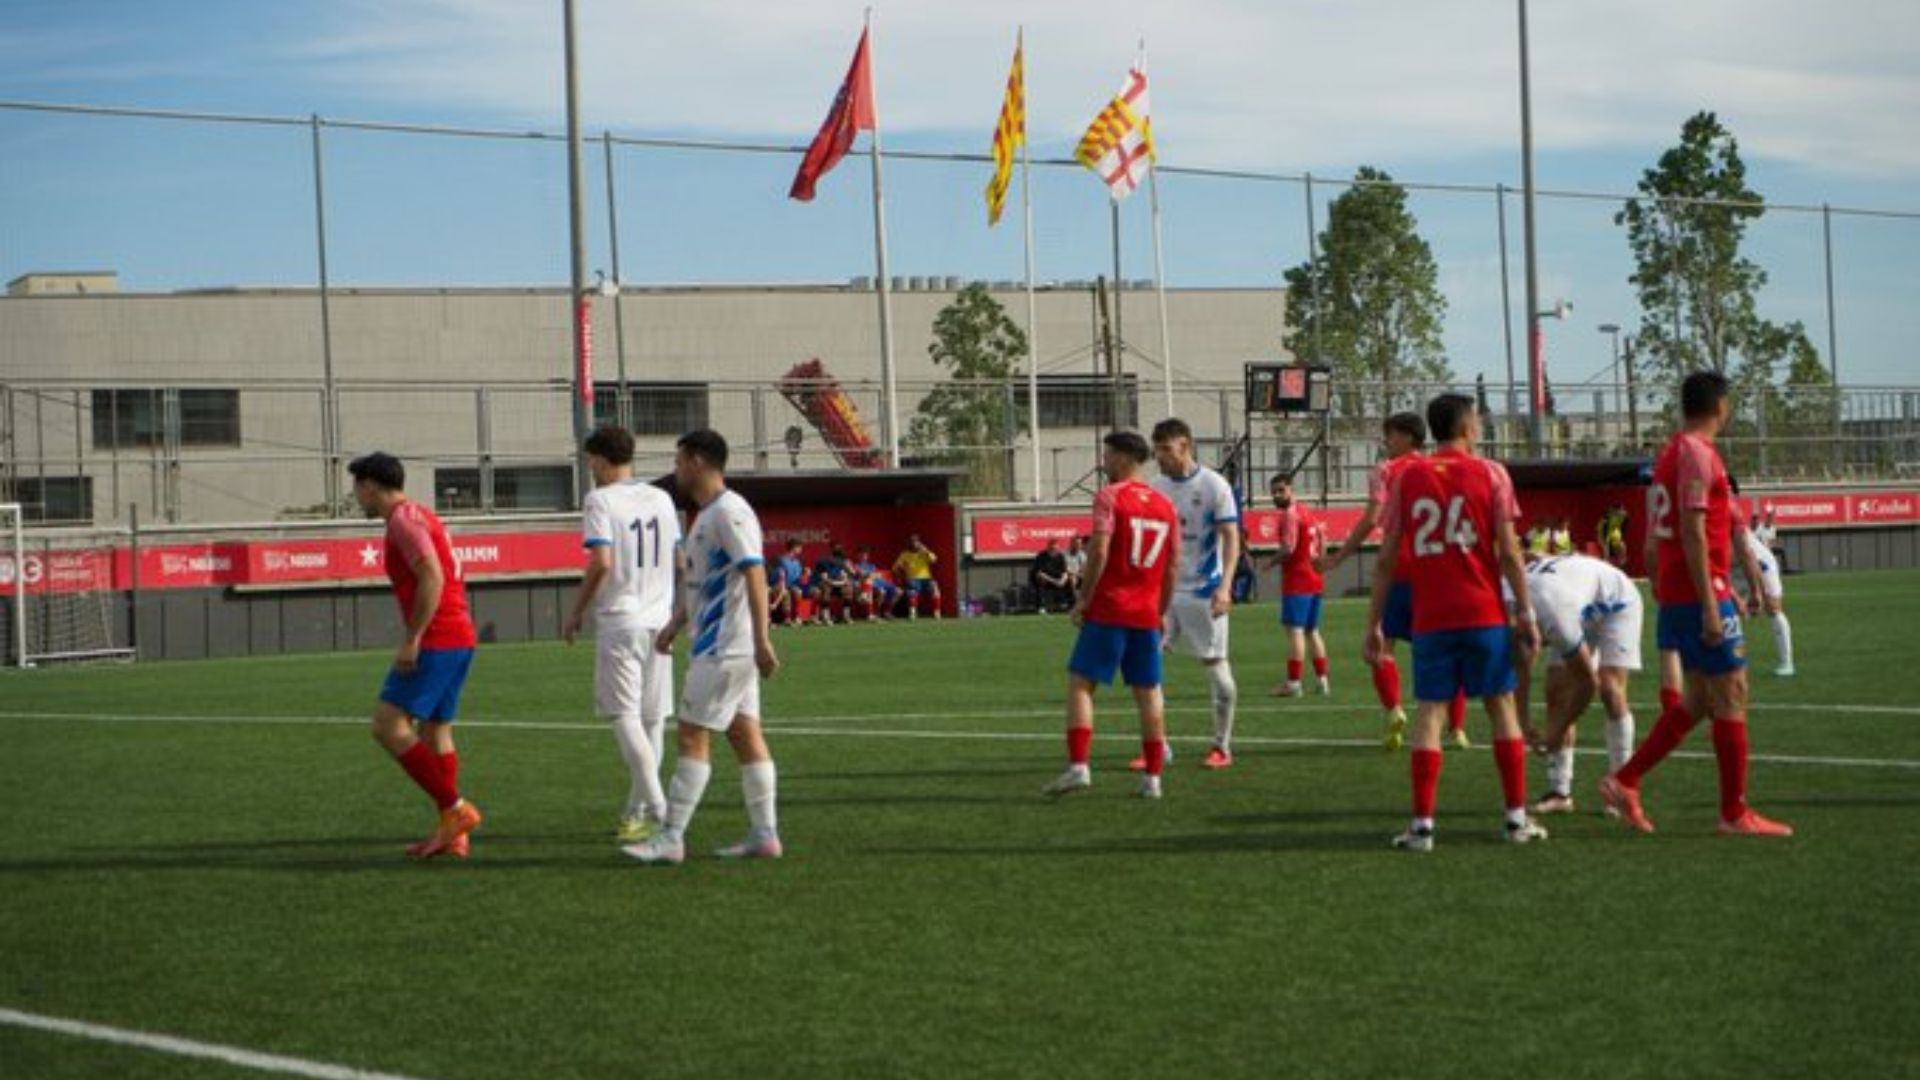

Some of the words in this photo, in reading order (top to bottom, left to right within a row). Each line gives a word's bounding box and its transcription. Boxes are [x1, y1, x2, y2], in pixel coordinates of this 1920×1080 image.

[629, 516, 660, 568] 11
[1129, 517, 1170, 568] 17
[1412, 496, 1477, 557] 24
